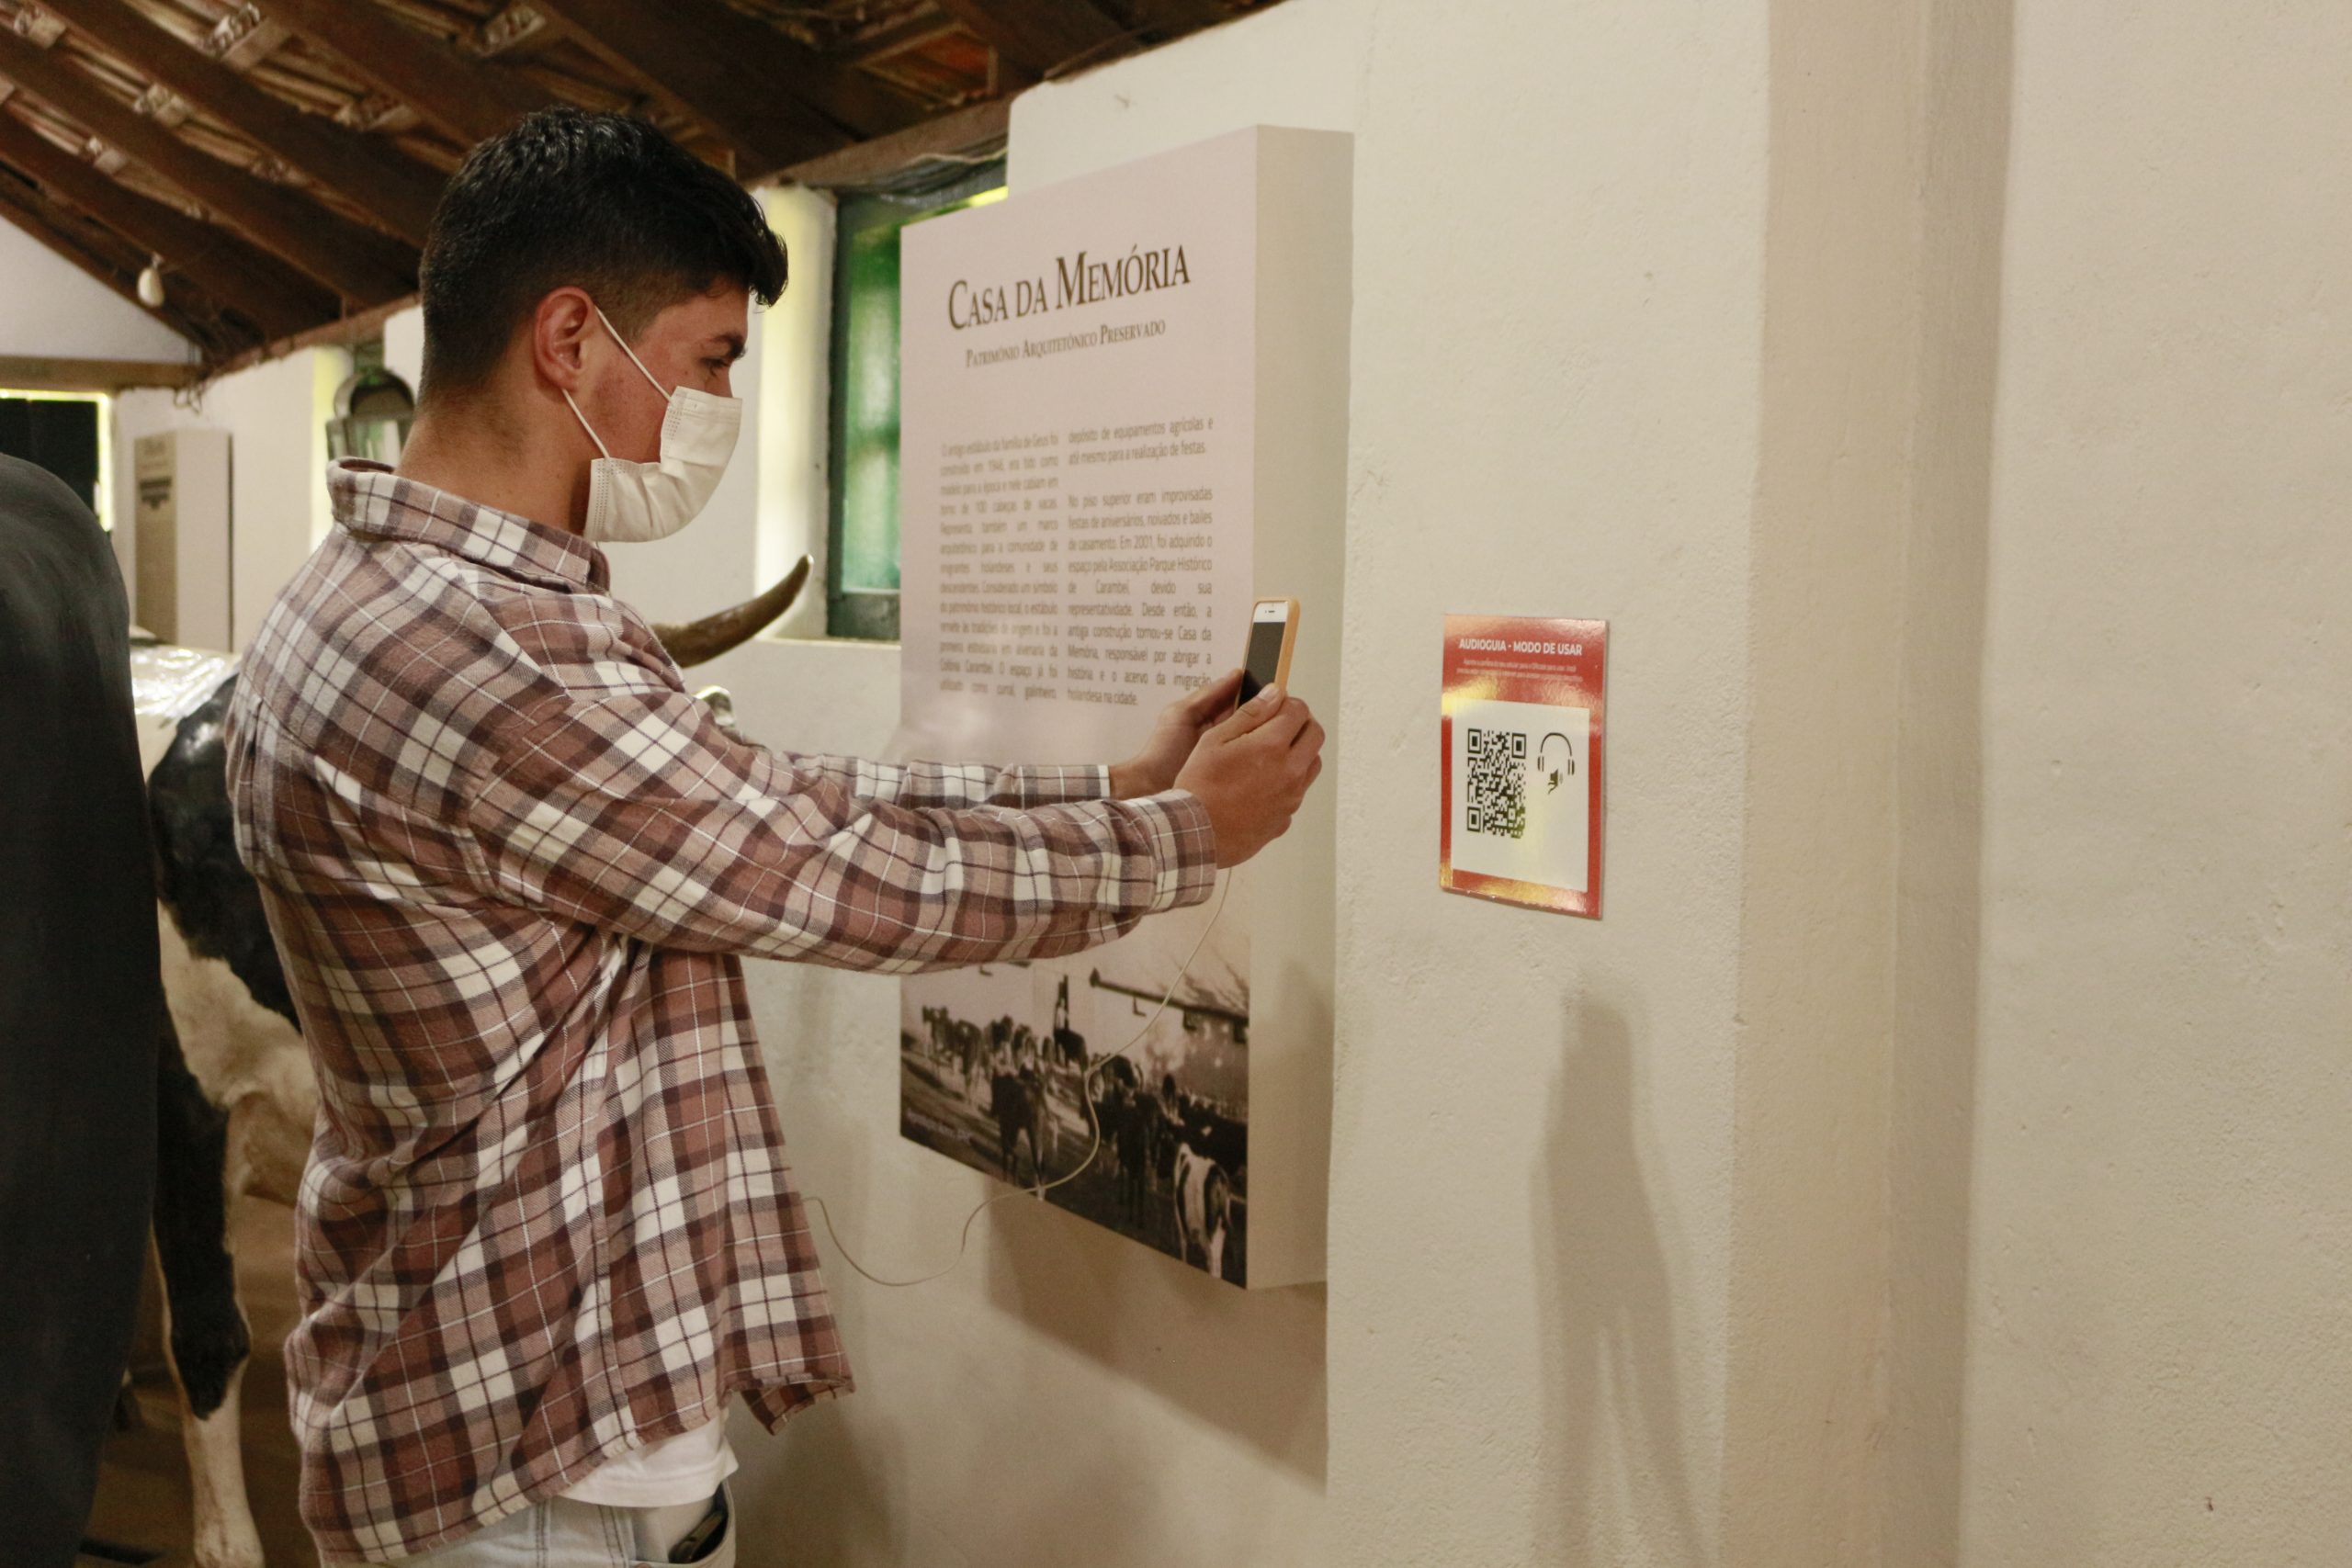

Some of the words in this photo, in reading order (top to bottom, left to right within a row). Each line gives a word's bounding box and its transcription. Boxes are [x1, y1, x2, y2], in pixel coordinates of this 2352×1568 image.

[1015, 277, 1048, 317] DA
[1056, 243, 1191, 310] MEMÓRIA
[1101, 320, 1166, 345] PRESERVADO
[1120, 536, 1132, 549] Em
[1109, 558, 1148, 574] Associação
[1150, 557, 1176, 572] Parque
[1198, 582, 1212, 594] sua
[1142, 603, 1165, 616] Desde
[1178, 626, 1197, 640] Casa
[1202, 627, 1211, 641] da
[1106, 646, 1148, 662] responsável
[1154, 651, 1167, 663] por
[1459, 638, 1507, 651] AUDIOGUIA
[1514, 641, 1541, 653] MODO
[1544, 642, 1555, 654] DE
[1557, 643, 1582, 656] USAR
[1125, 671, 1148, 684] acervo
